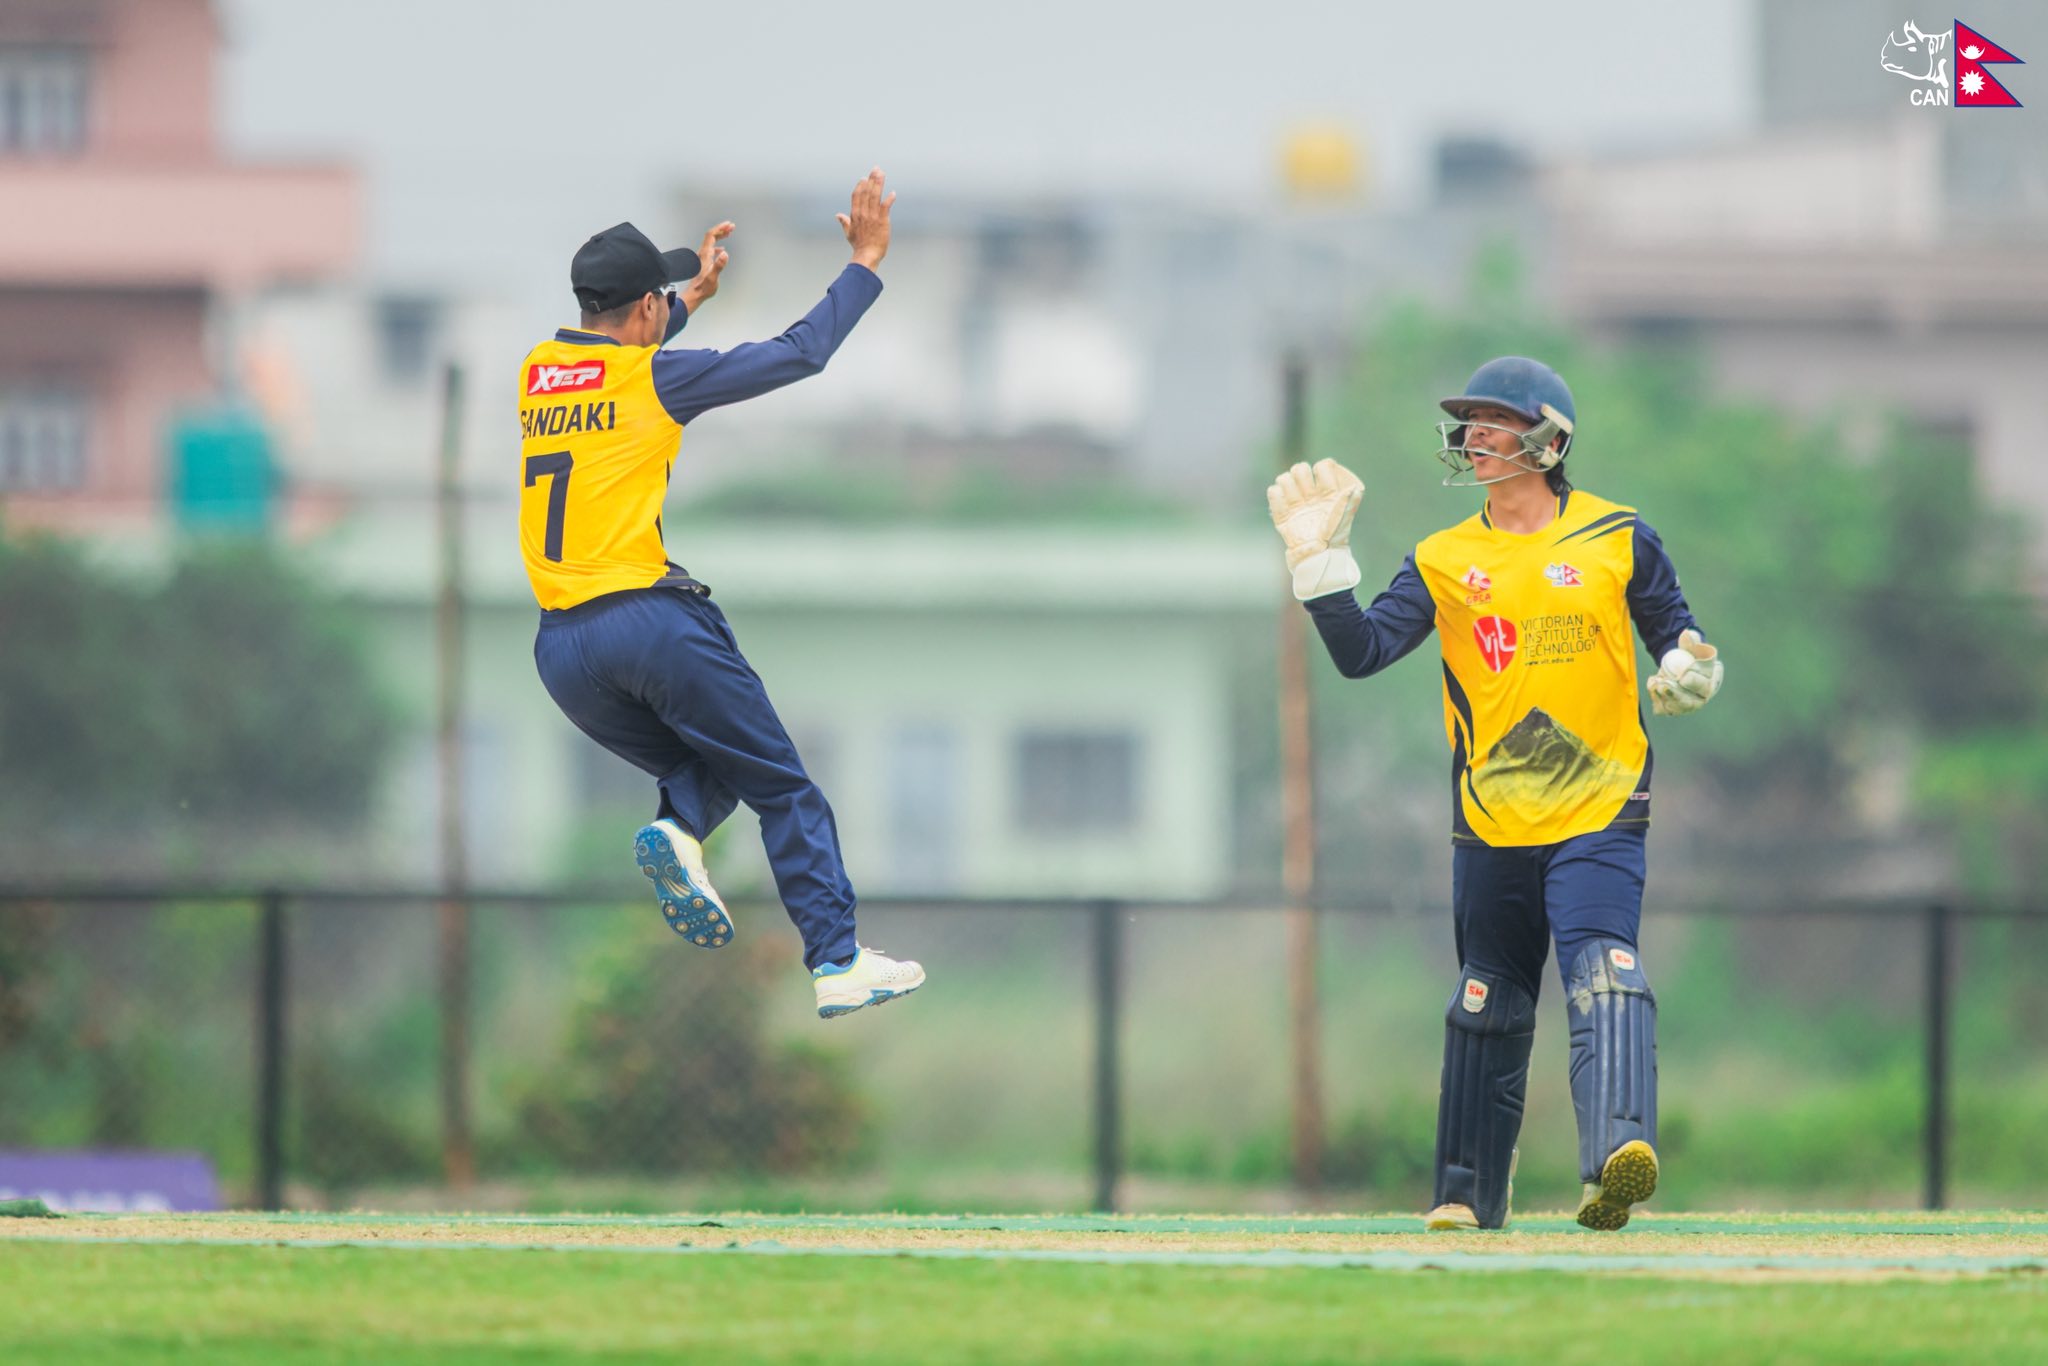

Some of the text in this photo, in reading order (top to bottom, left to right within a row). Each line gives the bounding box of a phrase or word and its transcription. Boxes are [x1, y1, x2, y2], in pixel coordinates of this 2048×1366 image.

[528, 366, 602, 394] XTEP
[525, 450, 574, 563] 7
[1520, 614, 1583, 631] VICTORIAN
[1524, 624, 1601, 645] INSTITUTE OF
[1523, 638, 1597, 657] TECHNOLOGY
